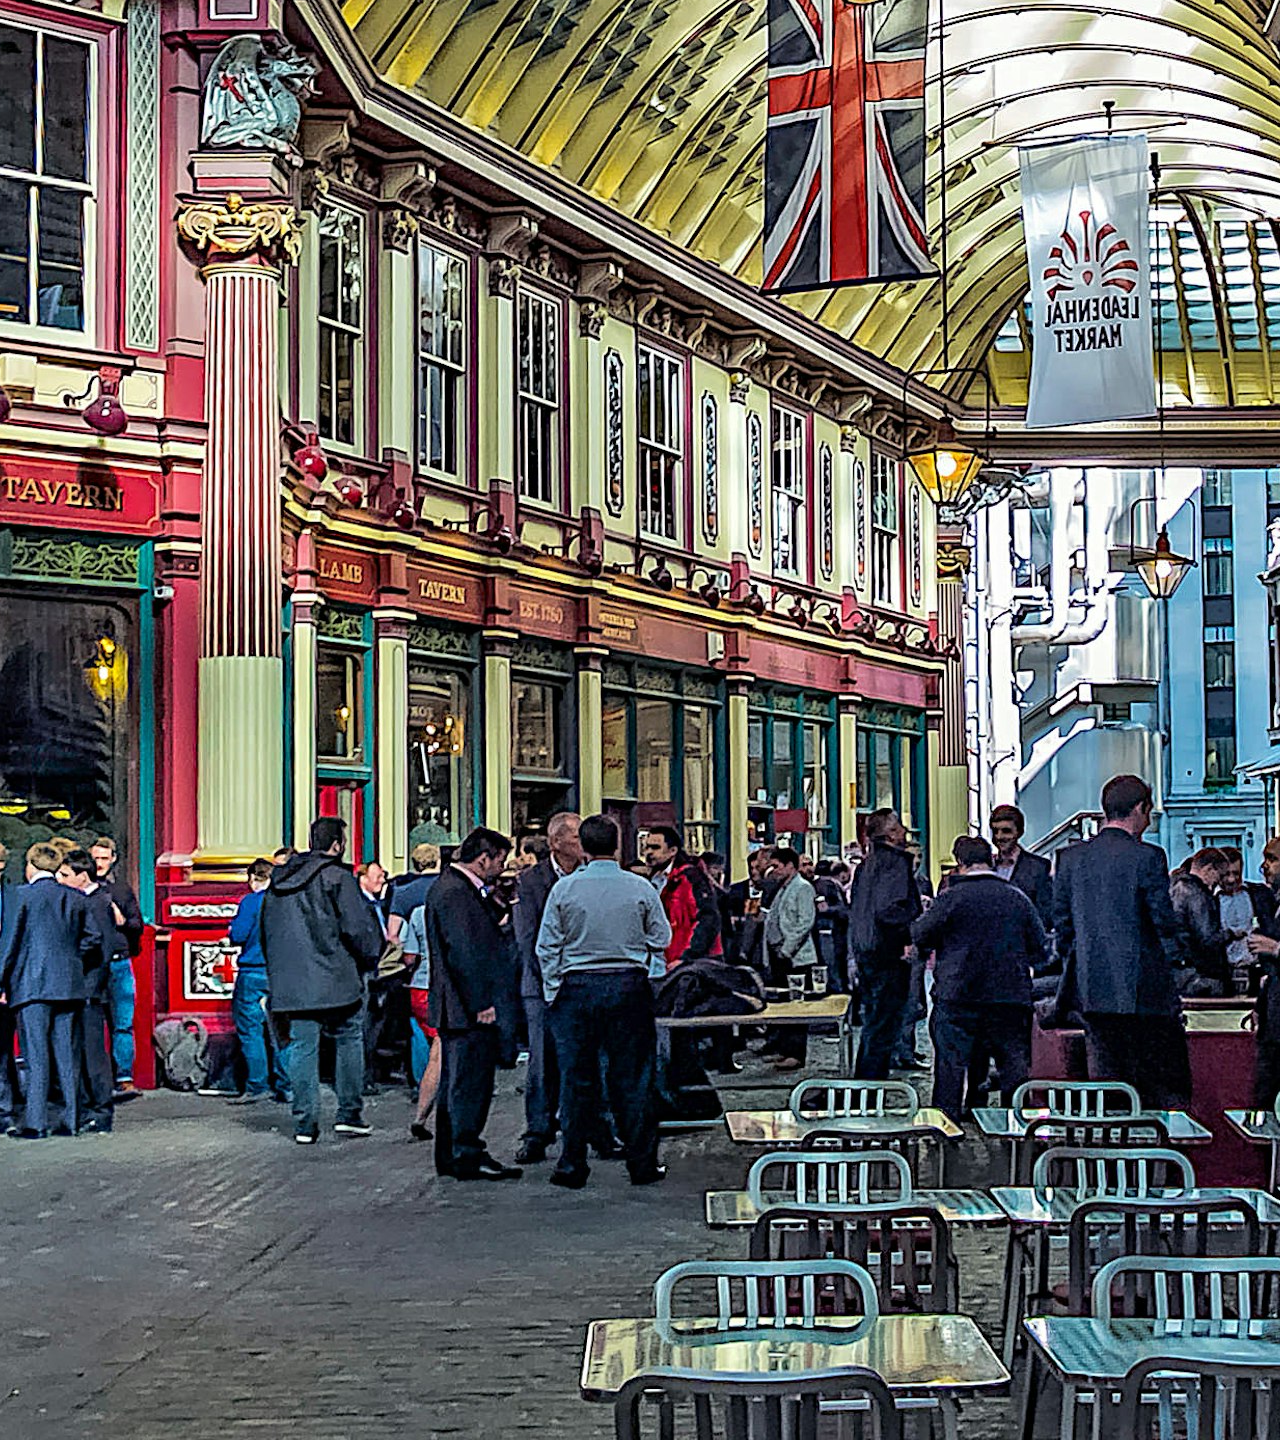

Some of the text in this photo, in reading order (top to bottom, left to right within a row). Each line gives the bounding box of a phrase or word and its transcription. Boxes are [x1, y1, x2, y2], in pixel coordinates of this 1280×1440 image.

[2, 477, 124, 512] TAVERN
[319, 558, 364, 584] LAMB
[418, 578, 467, 605] TAVERN
